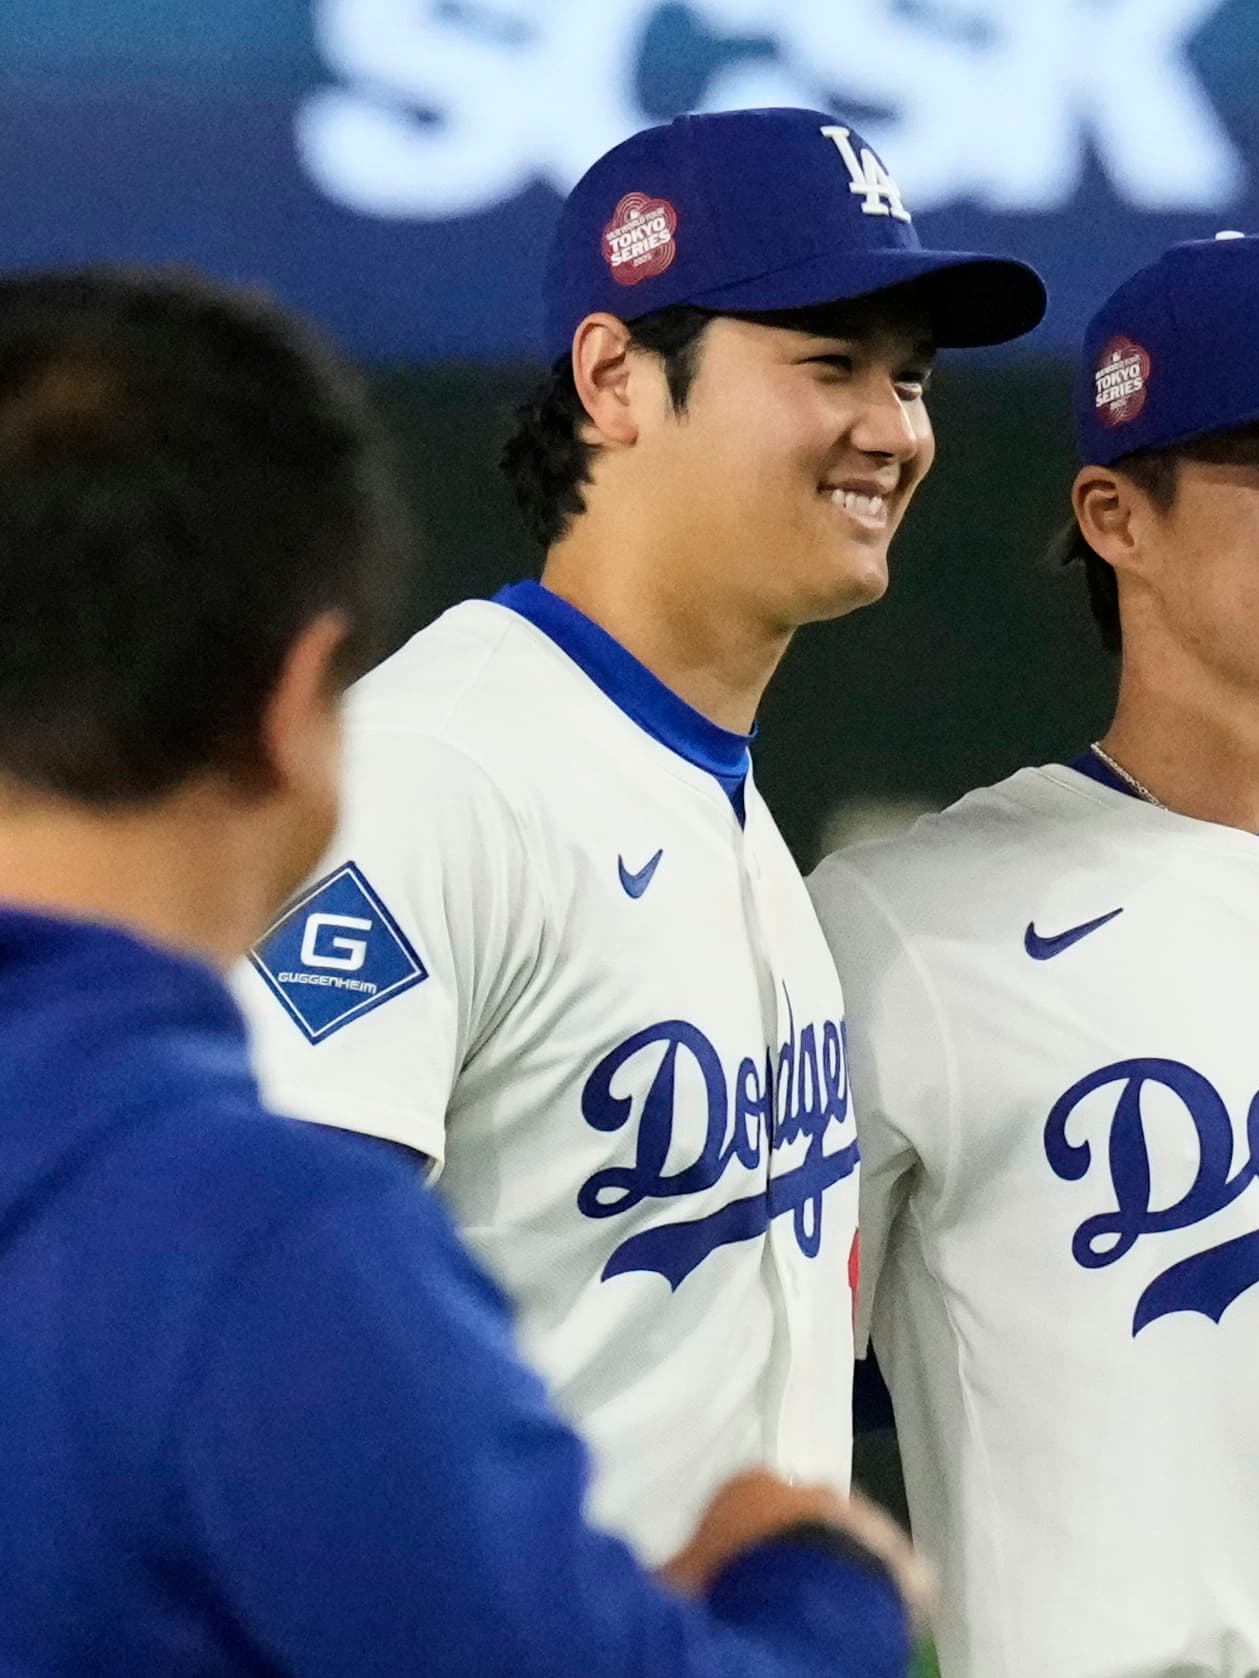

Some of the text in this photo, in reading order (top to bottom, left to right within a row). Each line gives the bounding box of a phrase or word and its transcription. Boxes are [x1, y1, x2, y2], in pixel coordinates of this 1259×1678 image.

[820, 126, 912, 224] LA
[609, 217, 666, 252] TOKYO
[610, 229, 671, 267] SERIES
[1095, 377, 1144, 408] SERIES
[1096, 364, 1140, 393] TOKYO
[300, 912, 373, 972] G
[277, 971, 378, 995] GUGGENHEIM
[577, 978, 850, 1258] Dodge
